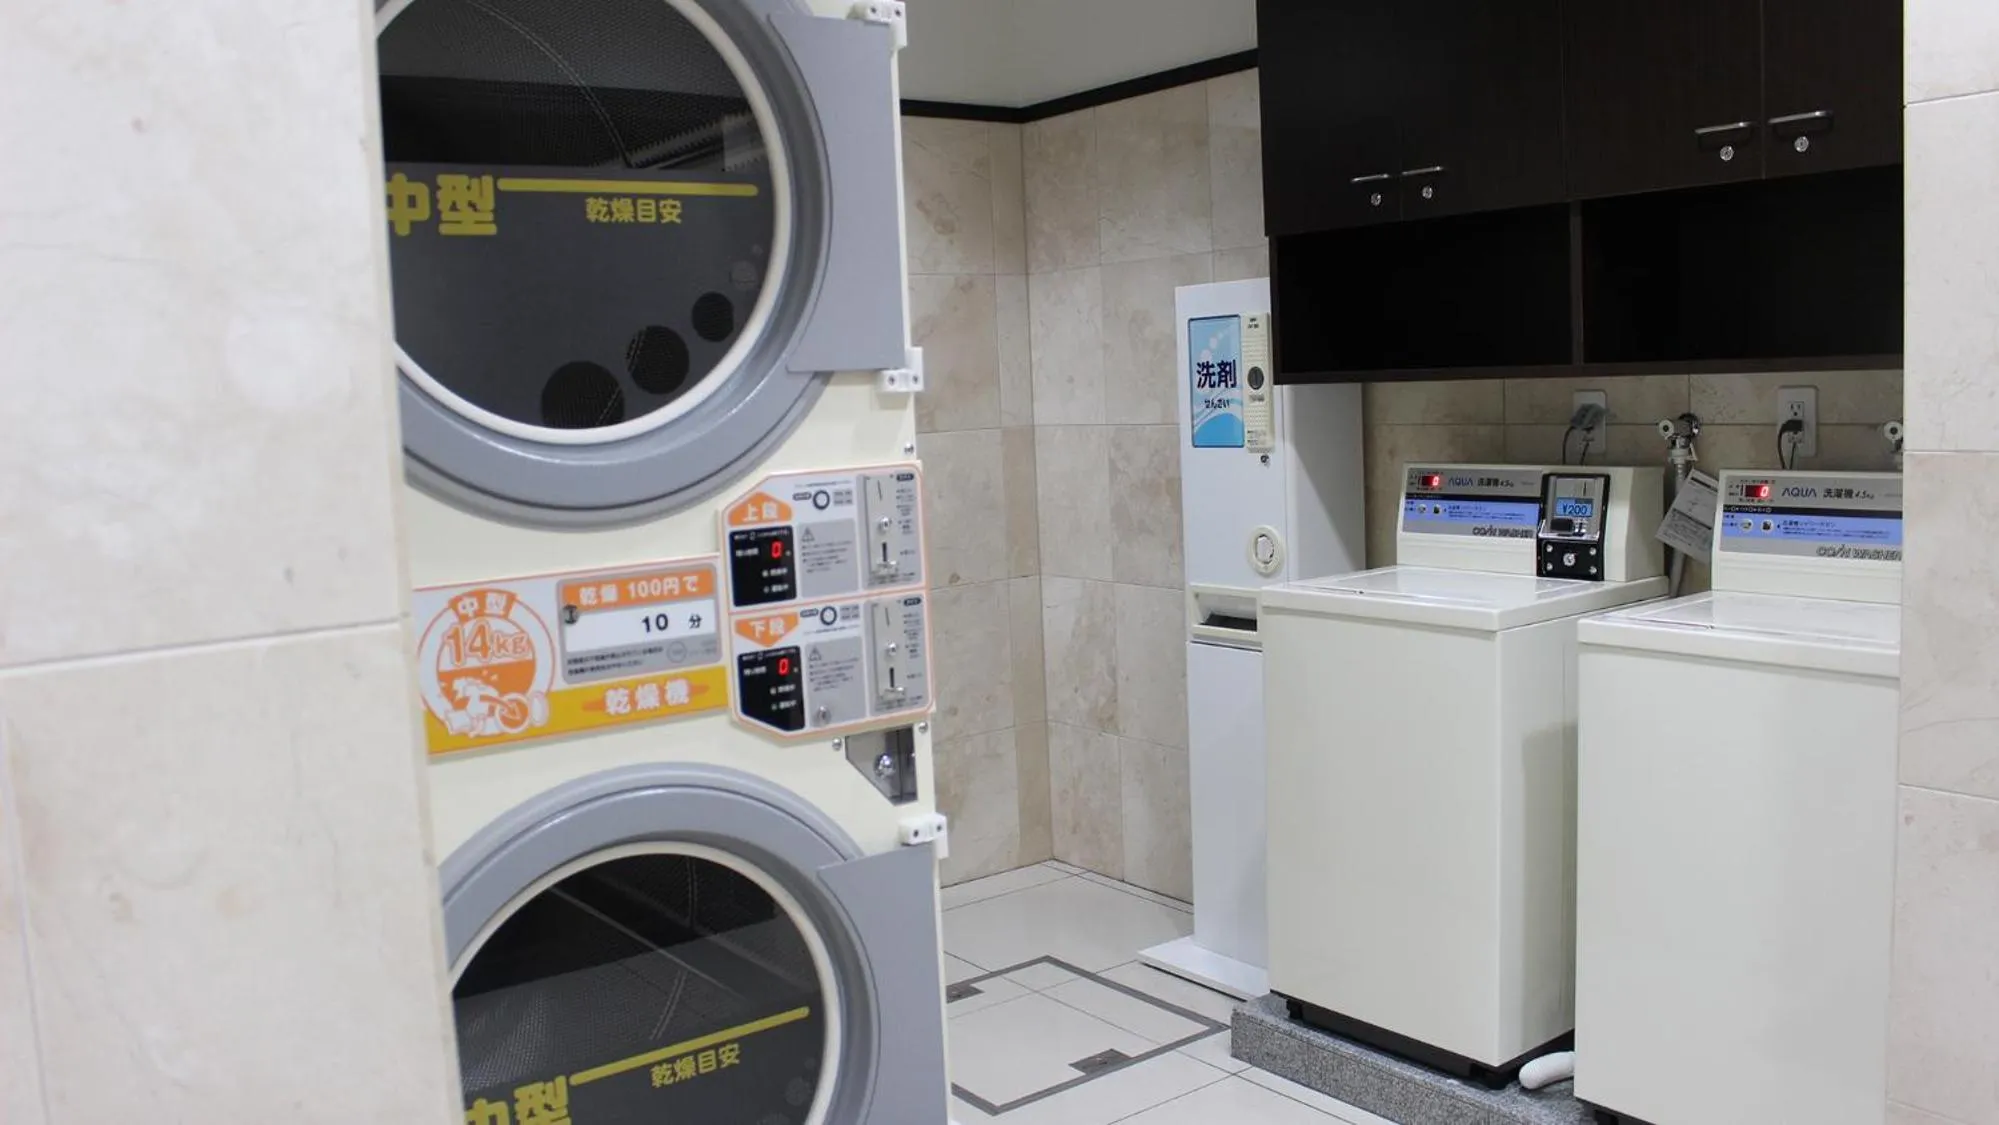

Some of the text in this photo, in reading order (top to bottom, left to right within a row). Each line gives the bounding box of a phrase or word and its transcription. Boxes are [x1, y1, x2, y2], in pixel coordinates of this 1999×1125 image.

[386, 172, 499, 237] 中型
[585, 196, 683, 225] 乾燥目安
[1196, 359, 1238, 389] 洗剤
[1761, 486, 1770, 498] 0
[1781, 487, 1817, 498] AQUA
[1823, 488, 1854, 500] 洗濯機
[1562, 503, 1588, 516] ¥200
[771, 540, 784, 560] 0
[457, 591, 508, 619] 中型
[641, 613, 703, 633] 10 分
[749, 618, 786, 638] 下段
[778, 657, 790, 676] 0
[604, 678, 690, 716] 乾燥機
[650, 1043, 742, 1089] 乾燥目安
